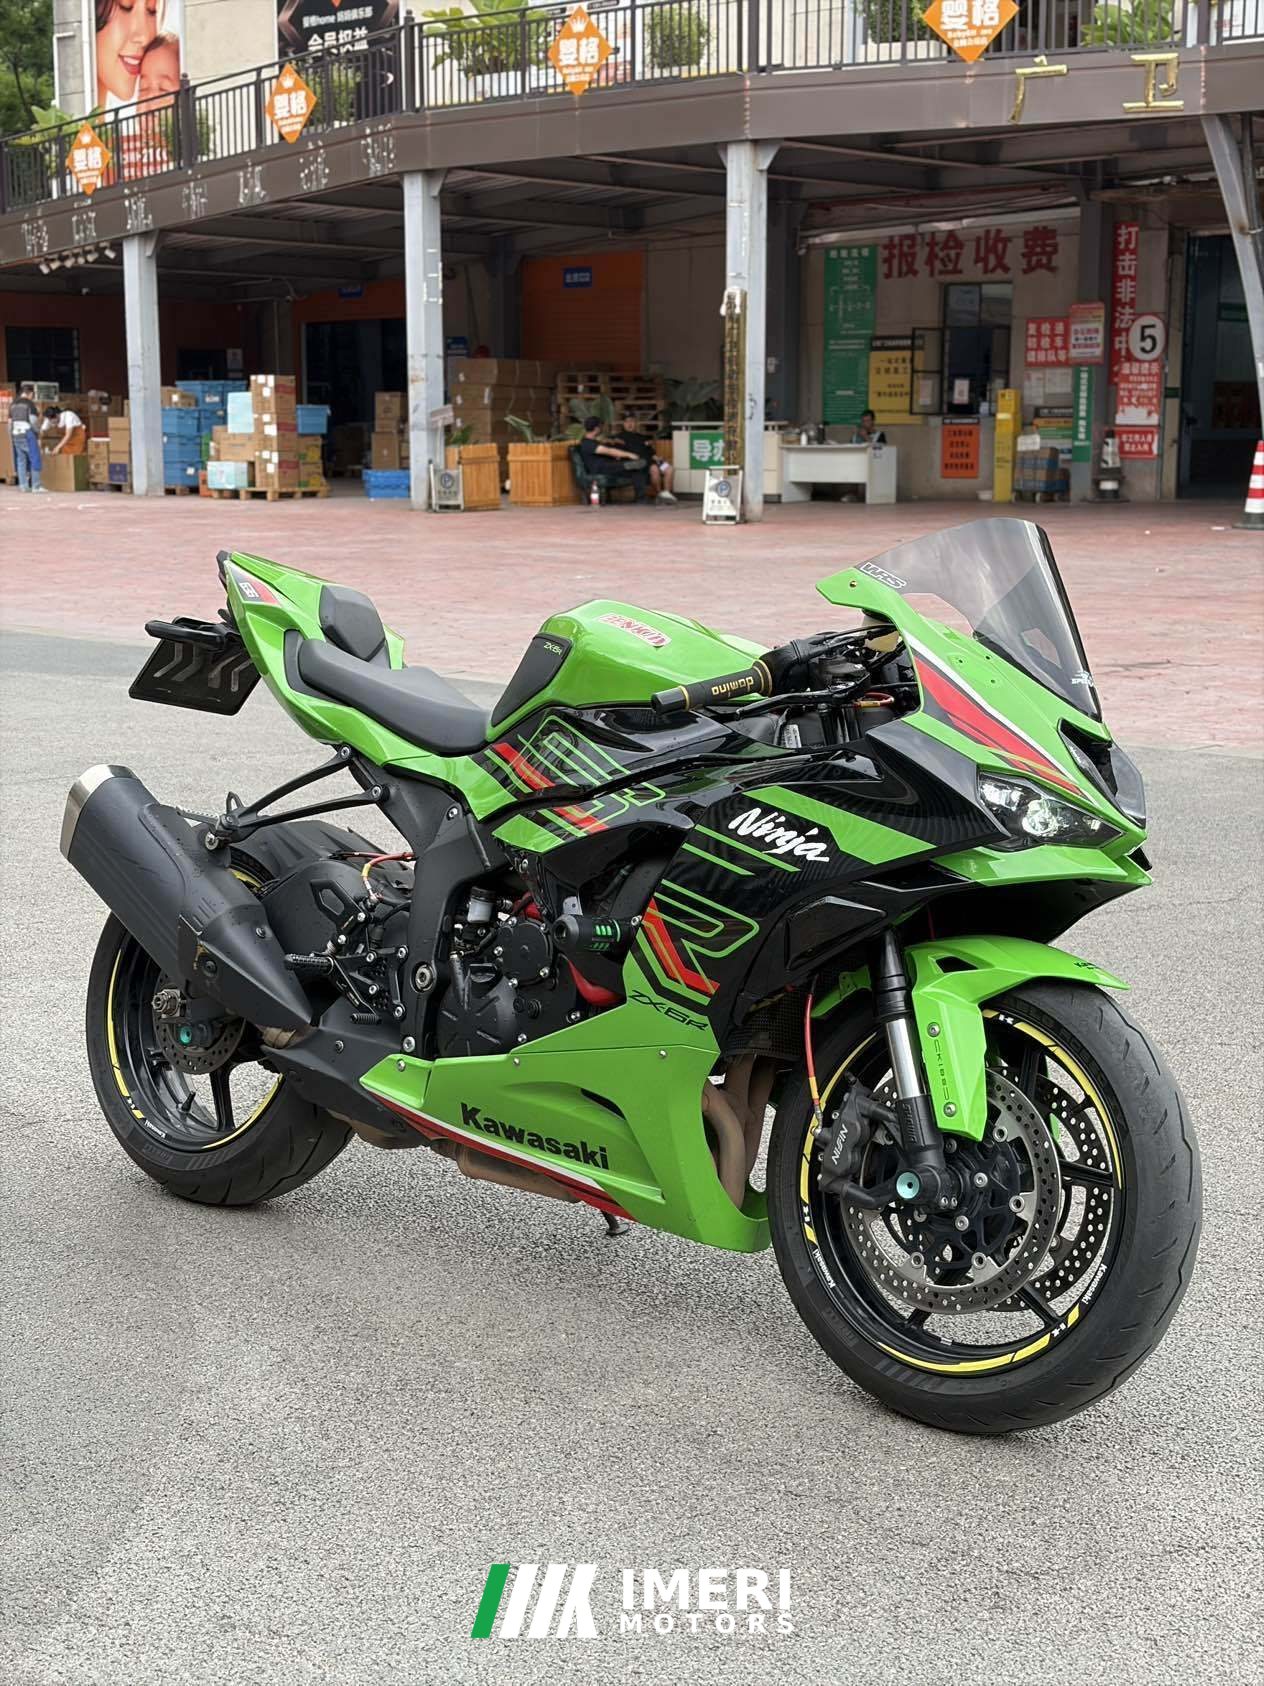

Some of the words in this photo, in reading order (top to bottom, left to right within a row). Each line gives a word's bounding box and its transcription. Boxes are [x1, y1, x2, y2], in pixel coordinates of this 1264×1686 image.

[882, 227, 1059, 280] 报检收费
[1113, 226, 1140, 382] 打击非法中
[1139, 323, 1158, 354] 5
[728, 807, 830, 862] Ninja
[628, 989, 708, 1031] ZX-6R
[460, 1102, 610, 1171] Kawasaki
[812, 1248, 836, 1289] Kawasaki
[1082, 1263, 1108, 1305] Kawasaki
